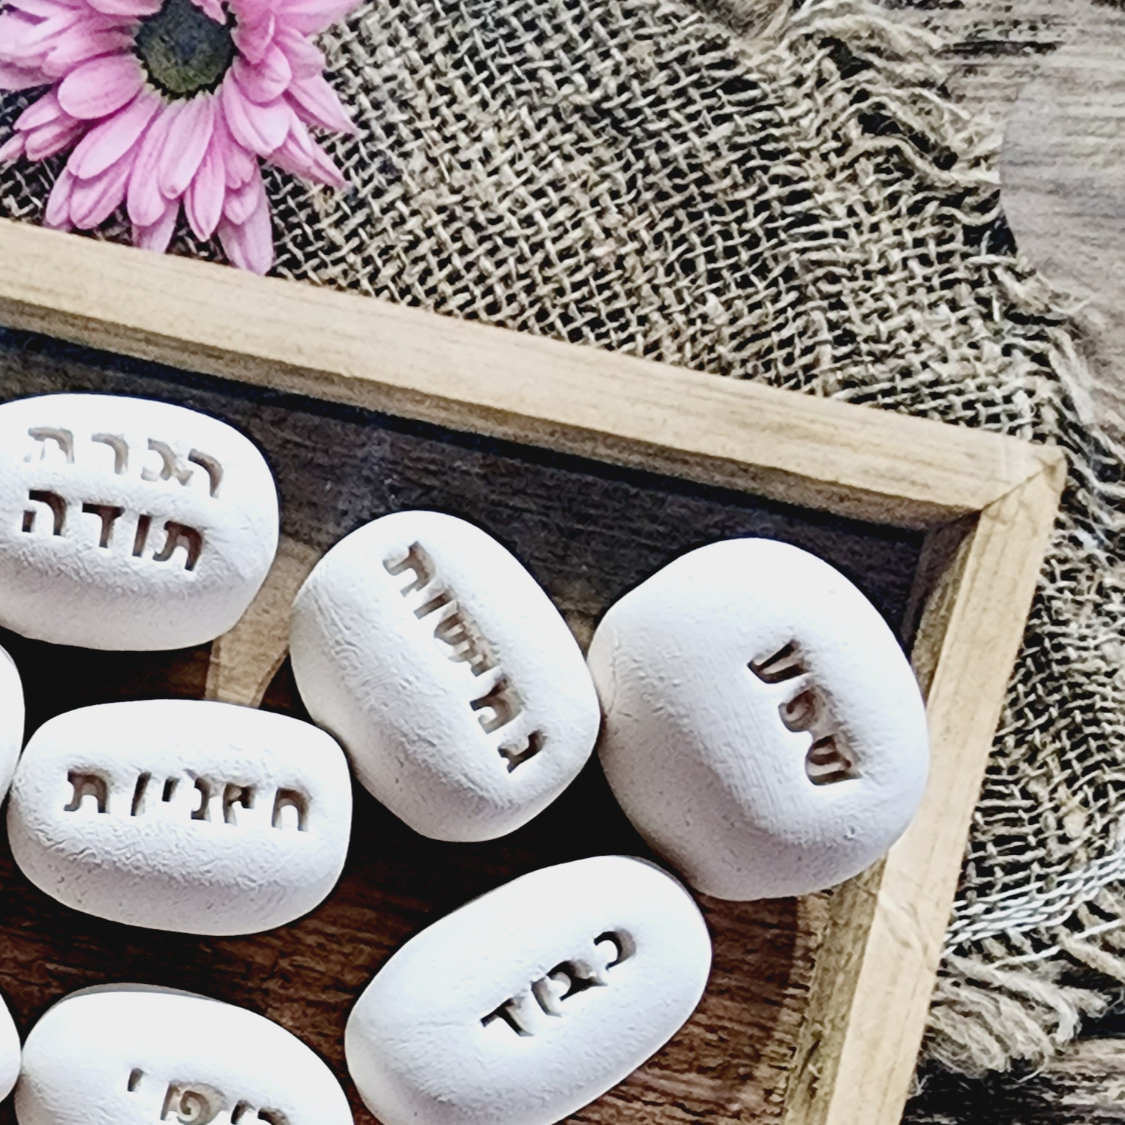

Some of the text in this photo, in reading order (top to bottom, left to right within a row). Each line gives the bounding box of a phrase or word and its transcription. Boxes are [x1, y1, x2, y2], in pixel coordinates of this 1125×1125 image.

[26, 426, 225, 500] הכרה
[21, 485, 206, 579] תודה
[383, 540, 550, 774] גמישות
[746, 634, 874, 787] שפע
[479, 927, 638, 1038] כבוד
